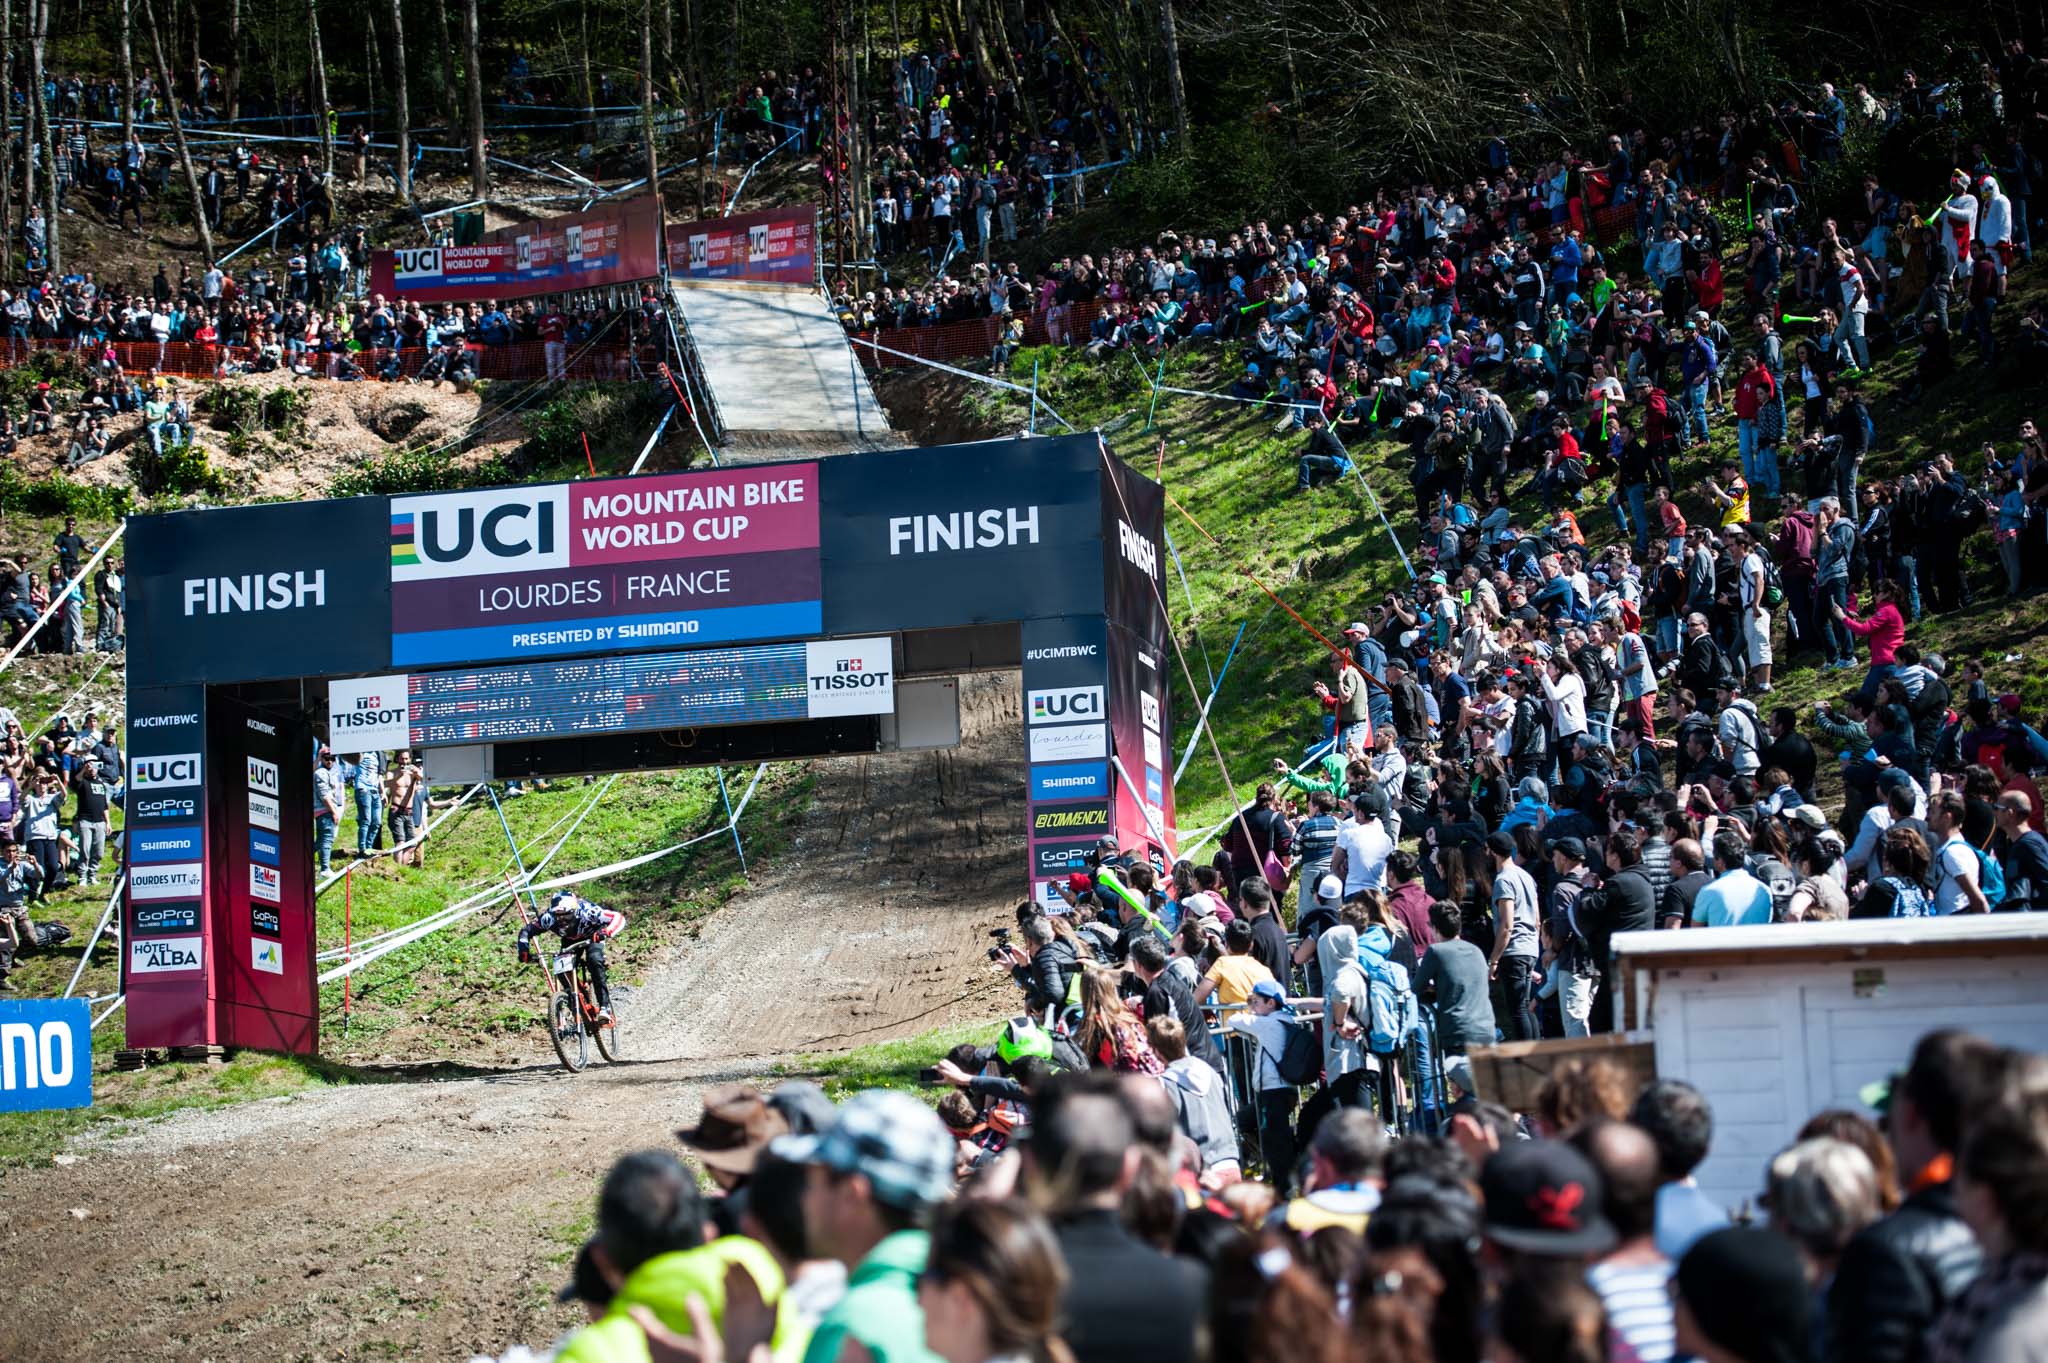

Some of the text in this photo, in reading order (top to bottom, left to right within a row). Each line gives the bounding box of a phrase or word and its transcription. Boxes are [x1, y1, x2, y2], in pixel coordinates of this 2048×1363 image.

[751, 231, 767, 253] UCI
[445, 247, 486, 258] MOUNTAIN
[487, 246, 503, 255] BIKE
[692, 240, 707, 263] UCI
[402, 250, 438, 273] UCI
[445, 258, 490, 269] WORLD CUP
[583, 479, 804, 520] MOUNTAIN BIKE
[421, 501, 555, 564] UCI
[583, 515, 749, 551] WORLD CUP
[889, 506, 1040, 556] FINISH
[1119, 519, 1158, 580] FINISH
[184, 569, 325, 616] FINISH
[480, 569, 731, 613] LOURDES FRANCE
[512, 620, 699, 648] PRESENTED BY SHIMANO
[1026, 645, 1097, 660] #UCIMTBWC
[415, 680, 423, 694] 1
[429, 676, 457, 692] USA
[810, 672, 889, 690] TISSOT
[1046, 692, 1098, 716] UCI
[134, 714, 198, 728] #UCIMTBWC
[332, 709, 405, 728] TISSOT
[430, 725, 457, 742] FRA
[148, 760, 196, 782] UCI
[255, 763, 276, 789] UCI
[1042, 775, 1096, 789] SHIMANO
[138, 799, 194, 811] GoPro
[249, 802, 265, 815] LOURDES
[141, 840, 191, 851] SHIMANO
[131, 874, 168, 886] LOURDES
[171, 873, 187, 883] VTT
[255, 866, 276, 884] BigMat
[138, 910, 195, 921] GoPro
[253, 909, 278, 924] GoPro
[134, 942, 172, 954] HÔTEL
[147, 950, 197, 967] ALBA
[560, 960, 565, 969] 1
[0, 1021, 73, 1090] NO
